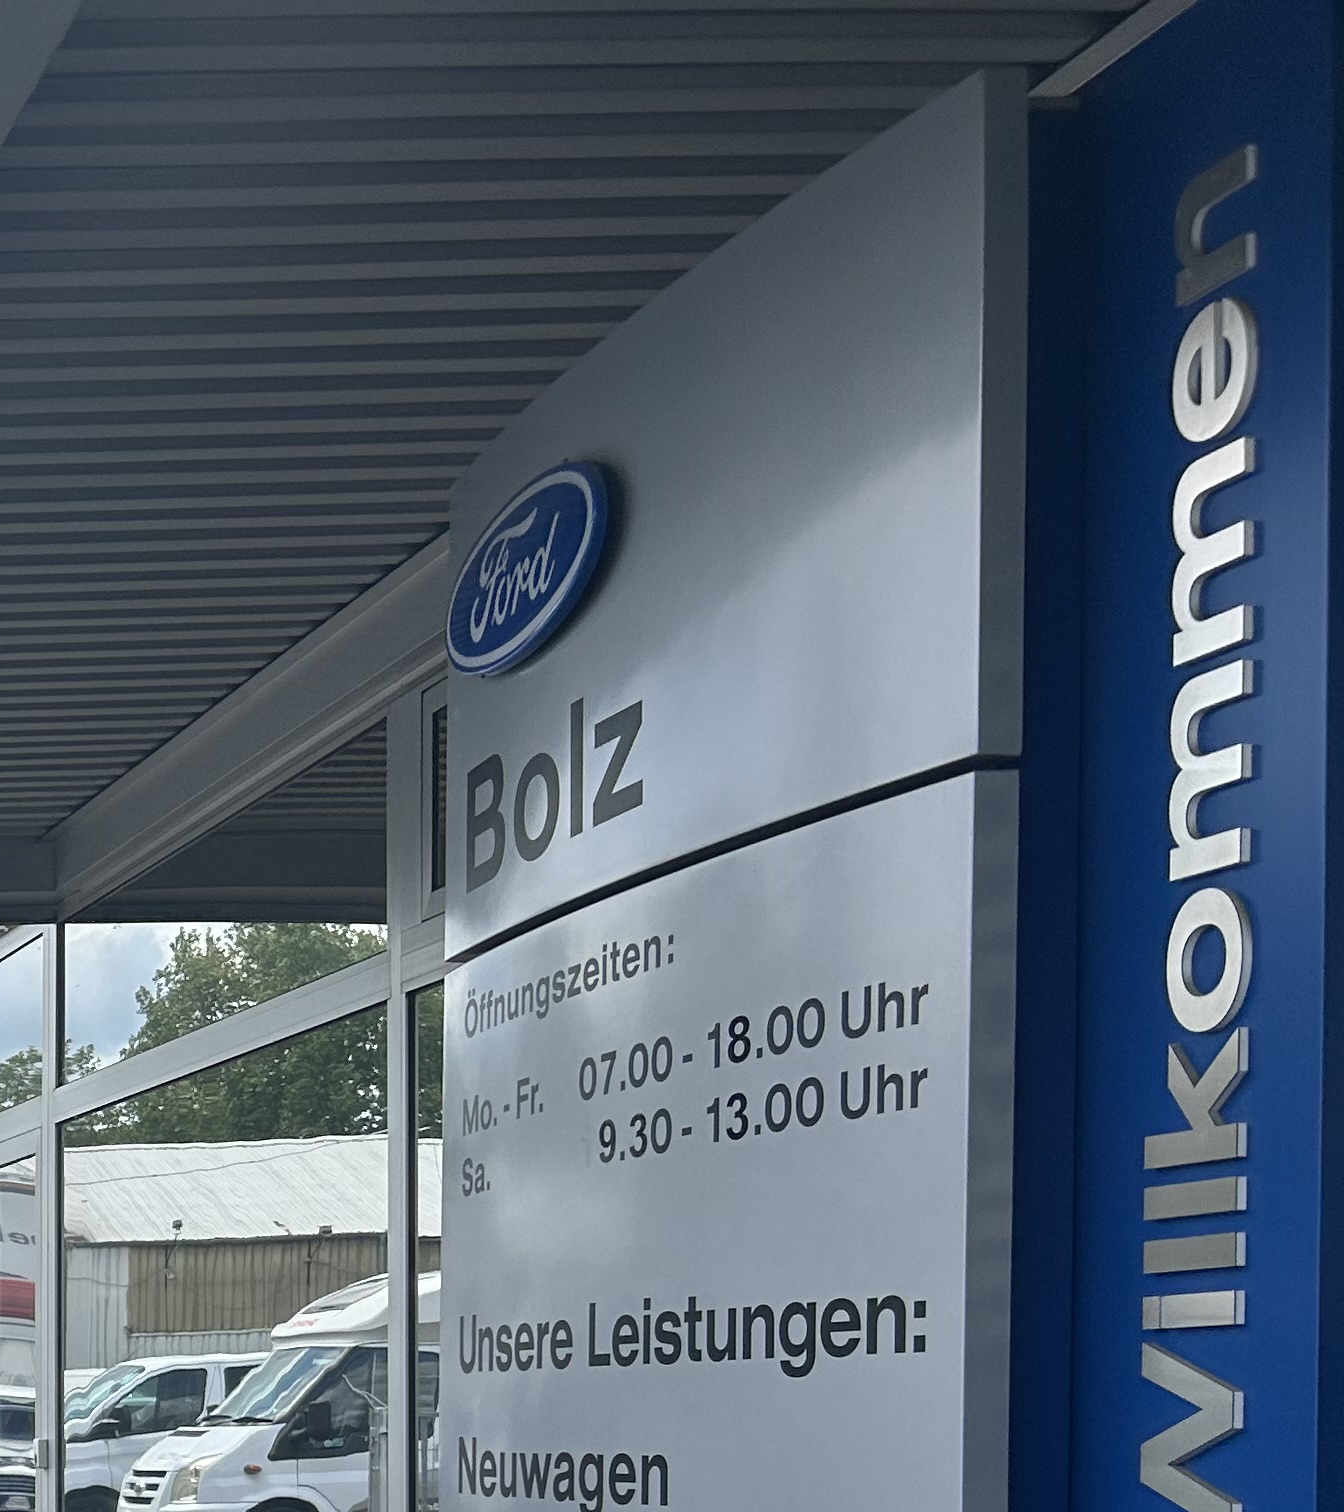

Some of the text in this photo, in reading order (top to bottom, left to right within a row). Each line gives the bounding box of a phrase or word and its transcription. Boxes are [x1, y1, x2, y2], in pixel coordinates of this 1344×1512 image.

[466, 697, 644, 894] Bolz
[463, 933, 676, 1039] Öffnungszeiten:
[840, 981, 930, 1040] Uhr
[461, 1156, 491, 1198] Sa.
[839, 1063, 929, 1120] Uhr
[458, 1294, 927, 1378] Unsere Leistungen:
